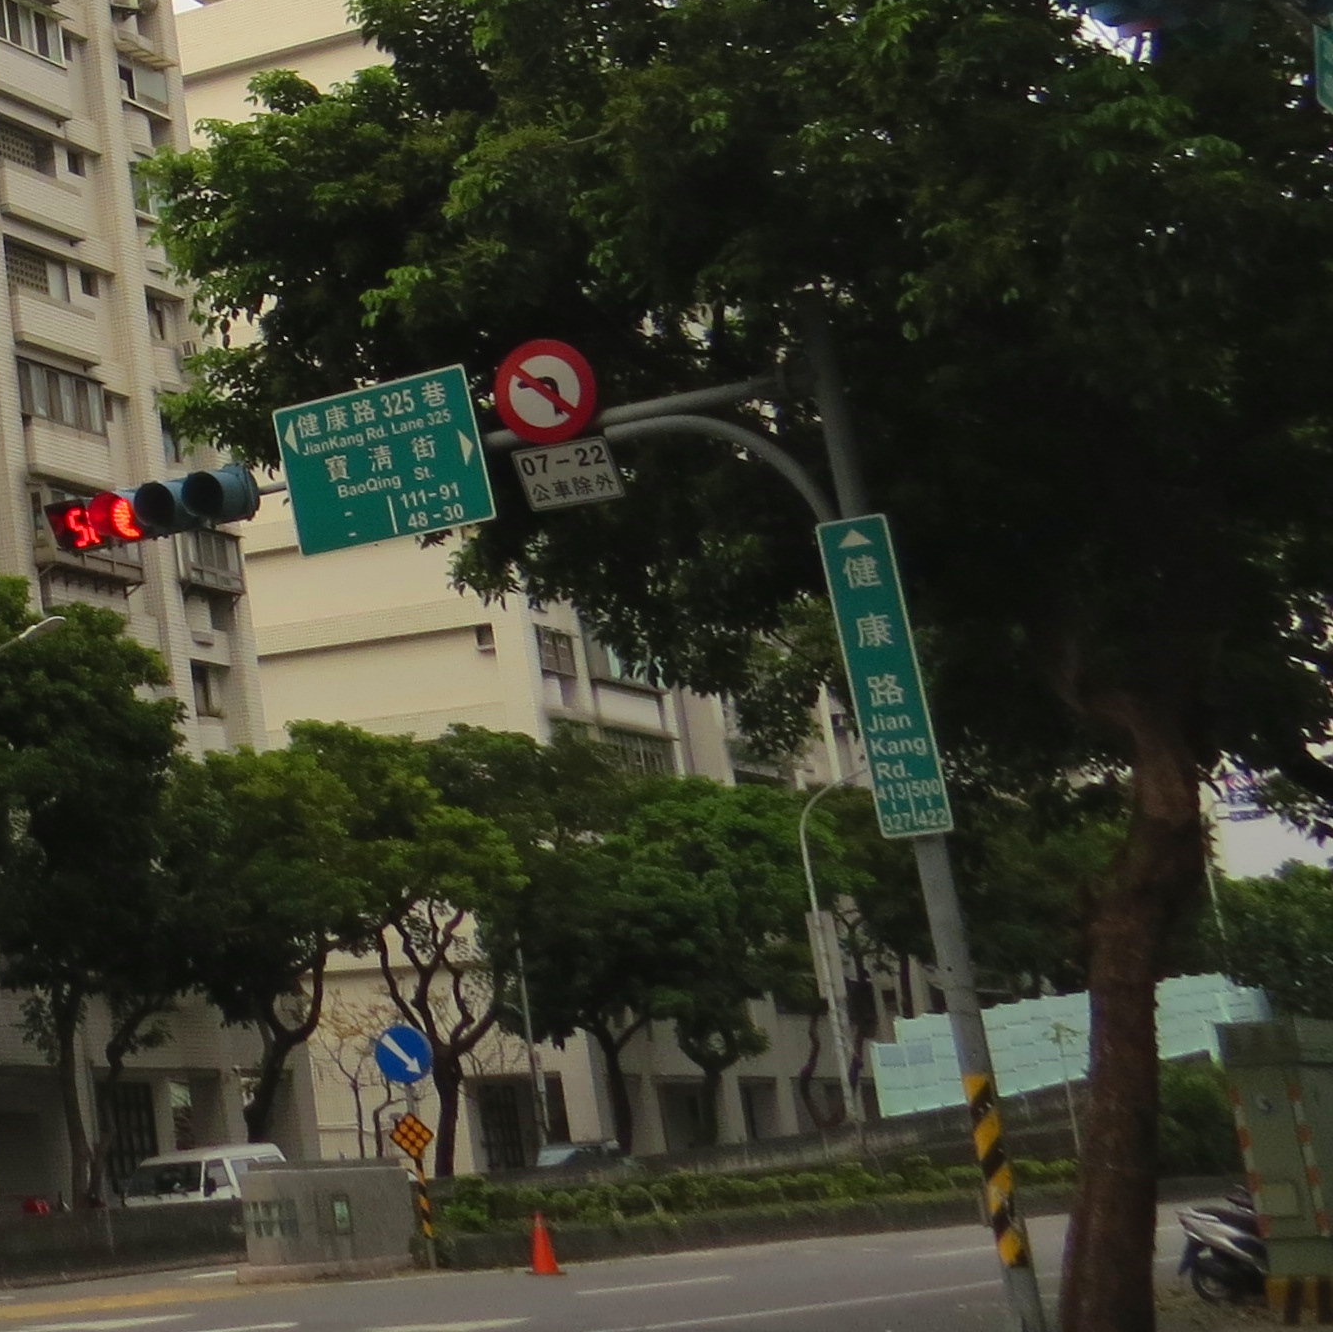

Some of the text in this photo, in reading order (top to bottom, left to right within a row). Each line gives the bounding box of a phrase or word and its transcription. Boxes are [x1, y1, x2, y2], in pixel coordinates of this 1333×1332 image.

[297, 381, 446, 438] 健康路325巷
[302, 409, 452, 456] JianKang Rd. Lane 325
[337, 467, 435, 498] BaoQing St.
[532, 472, 614, 502] 公車除外
[842, 554, 905, 708] 健康路
[868, 713, 912, 733] Jian
[870, 737, 928, 757] Kang
[875, 759, 913, 780] Rd.
